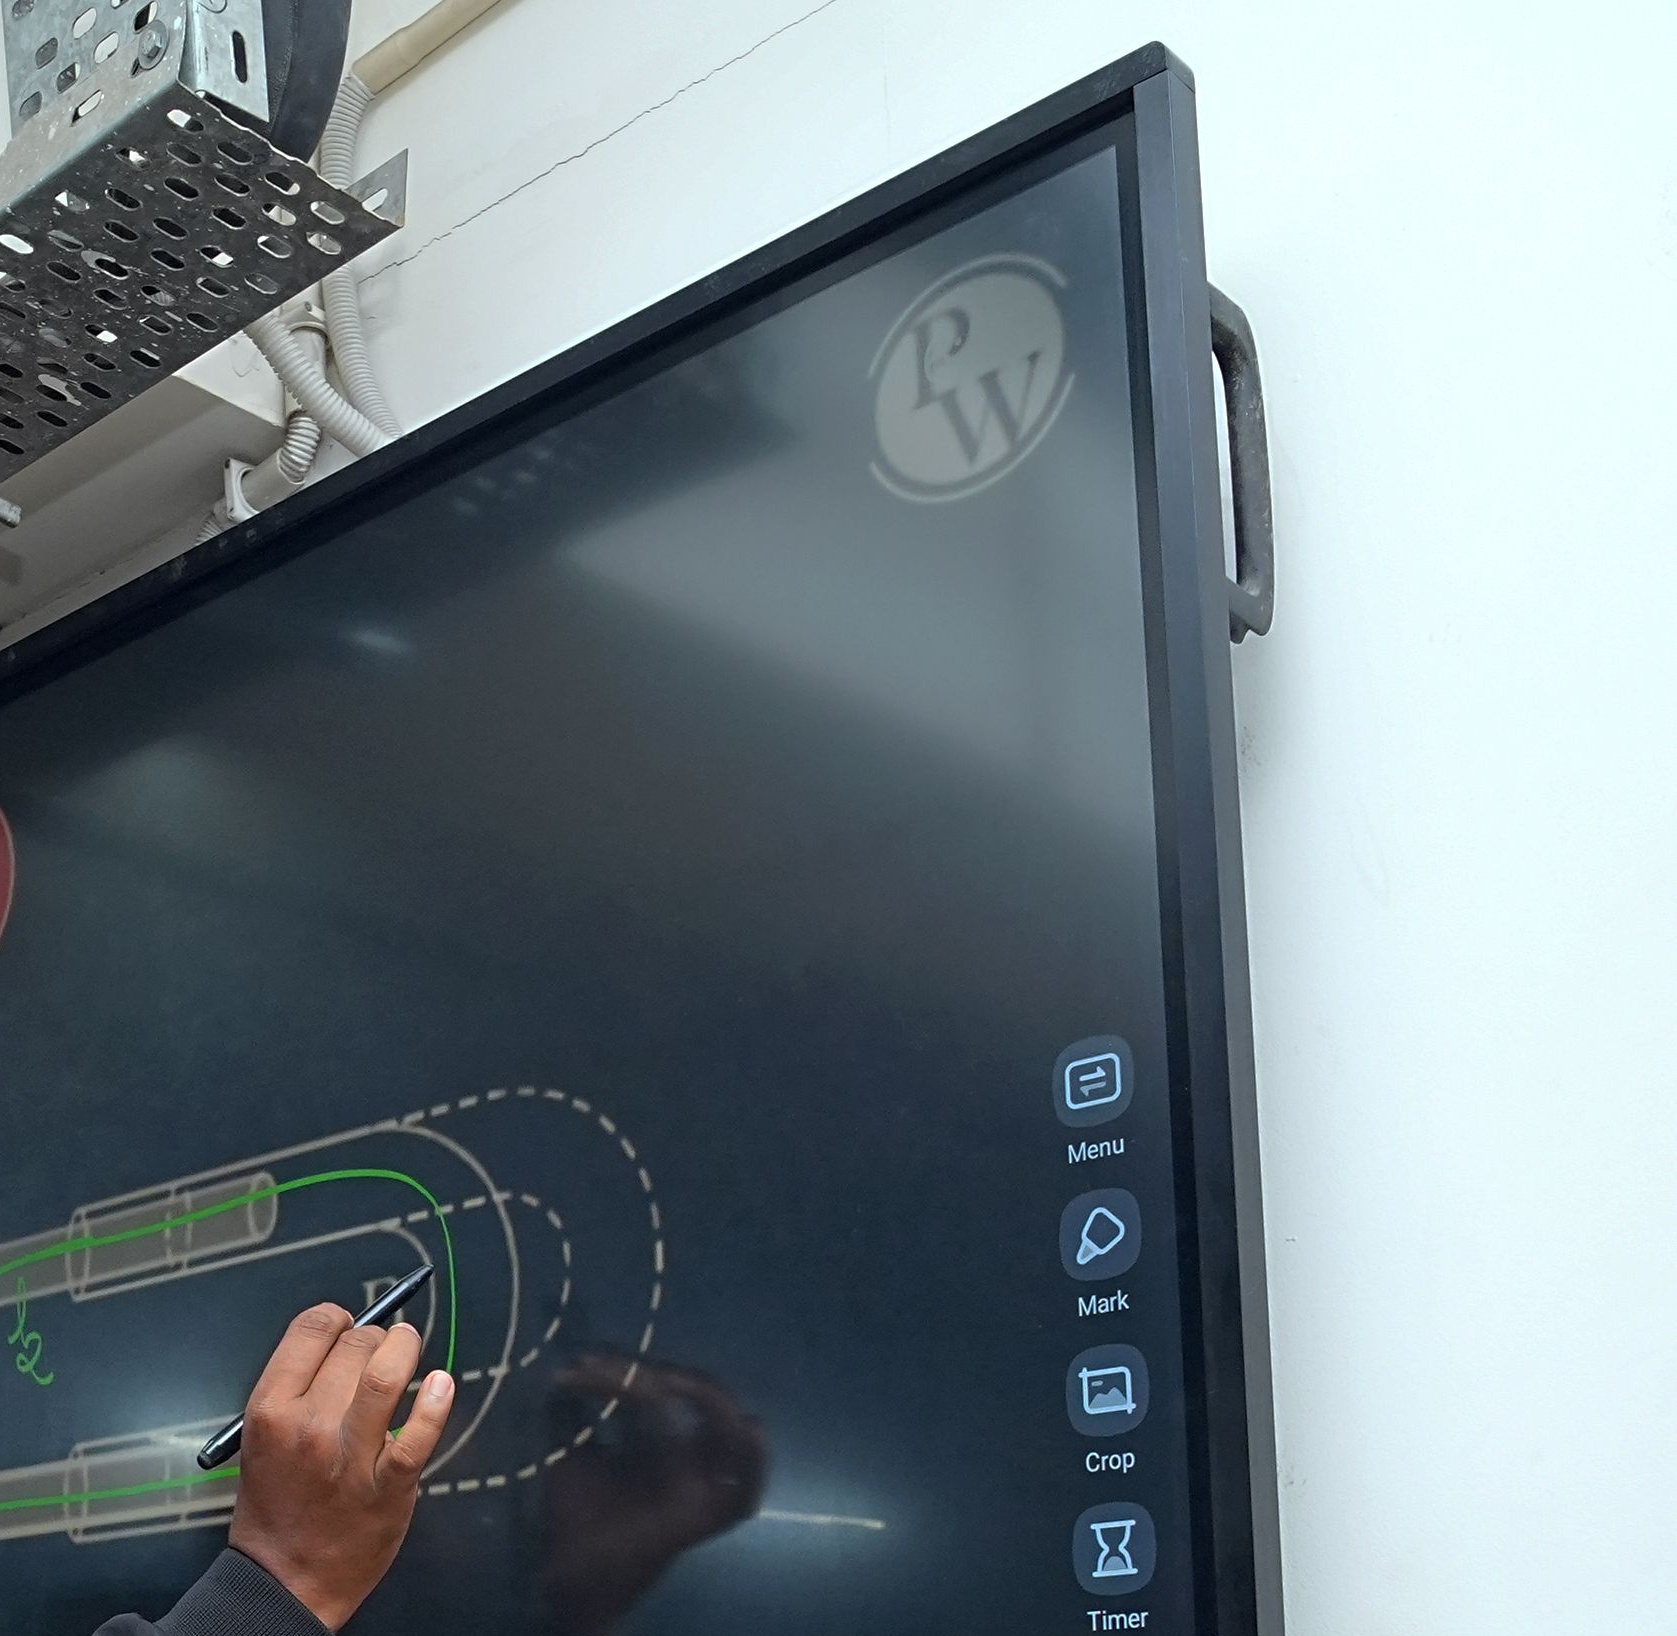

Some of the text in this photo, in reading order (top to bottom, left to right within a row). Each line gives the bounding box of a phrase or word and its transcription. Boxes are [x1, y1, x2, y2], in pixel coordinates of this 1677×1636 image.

[1067, 1137, 1125, 1164] Menu
[1077, 1290, 1130, 1318] Mark
[1085, 1451, 1136, 1473] Crop
[1087, 1610, 1149, 1632] Timer
